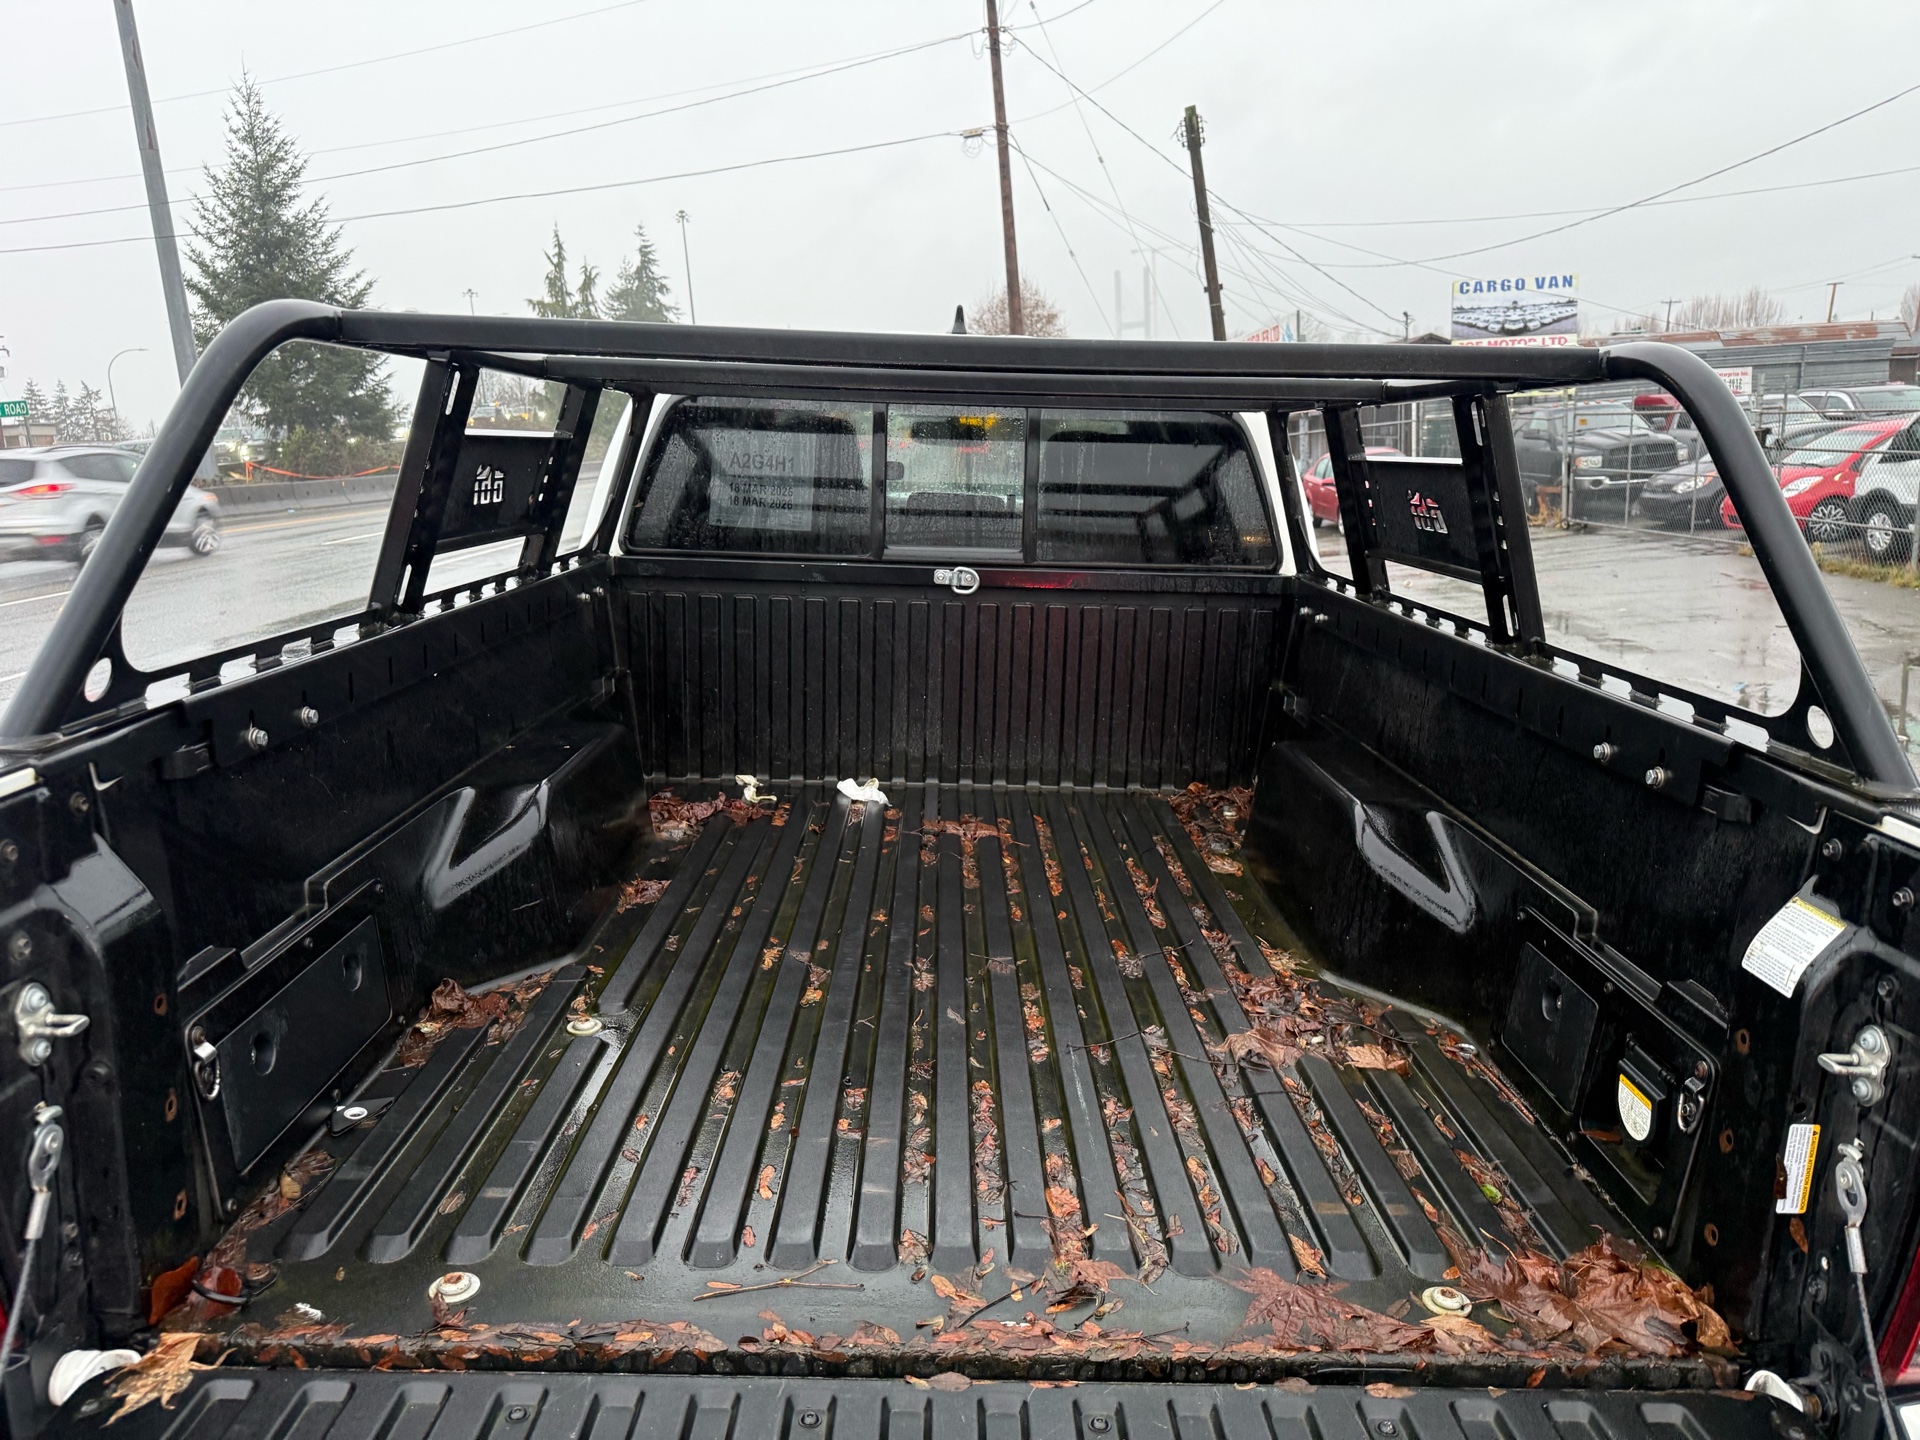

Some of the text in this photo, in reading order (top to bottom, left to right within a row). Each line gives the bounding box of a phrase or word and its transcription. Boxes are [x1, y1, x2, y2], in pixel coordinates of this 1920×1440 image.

[1459, 275, 1573, 295] CARGO VAN
[1542, 336, 1568, 346] LTD
[3, 402, 27, 416] ROAD
[742, 483, 766, 495] MAR
[770, 485, 794, 497] 2026
[742, 496, 766, 508] MAR
[769, 499, 793, 510] 2026
